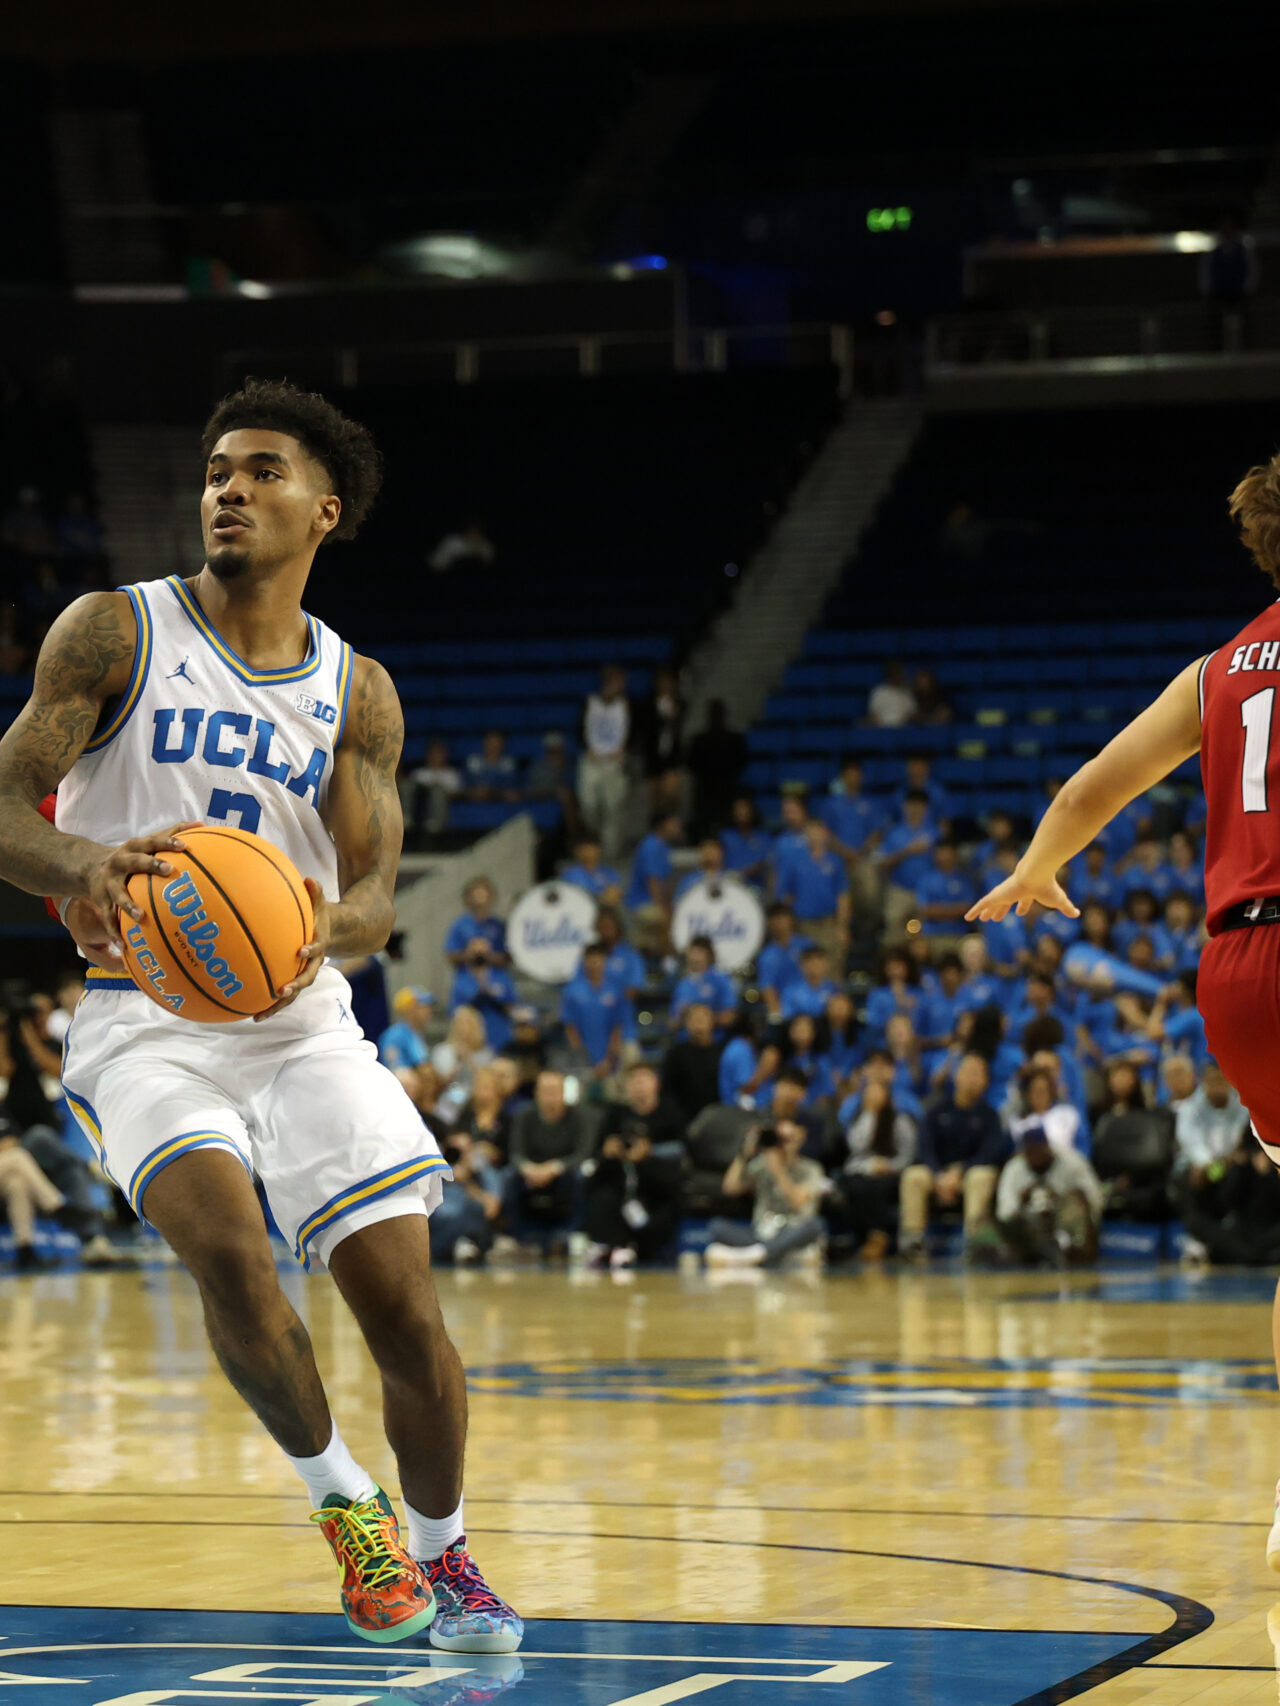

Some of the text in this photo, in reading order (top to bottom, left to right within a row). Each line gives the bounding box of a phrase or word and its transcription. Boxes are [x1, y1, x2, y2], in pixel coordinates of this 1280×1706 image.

[1227, 641, 1280, 675] SCH
[151, 708, 328, 808] UCLA
[126, 924, 187, 1011] UCLA
[162, 870, 244, 999] Wilson
